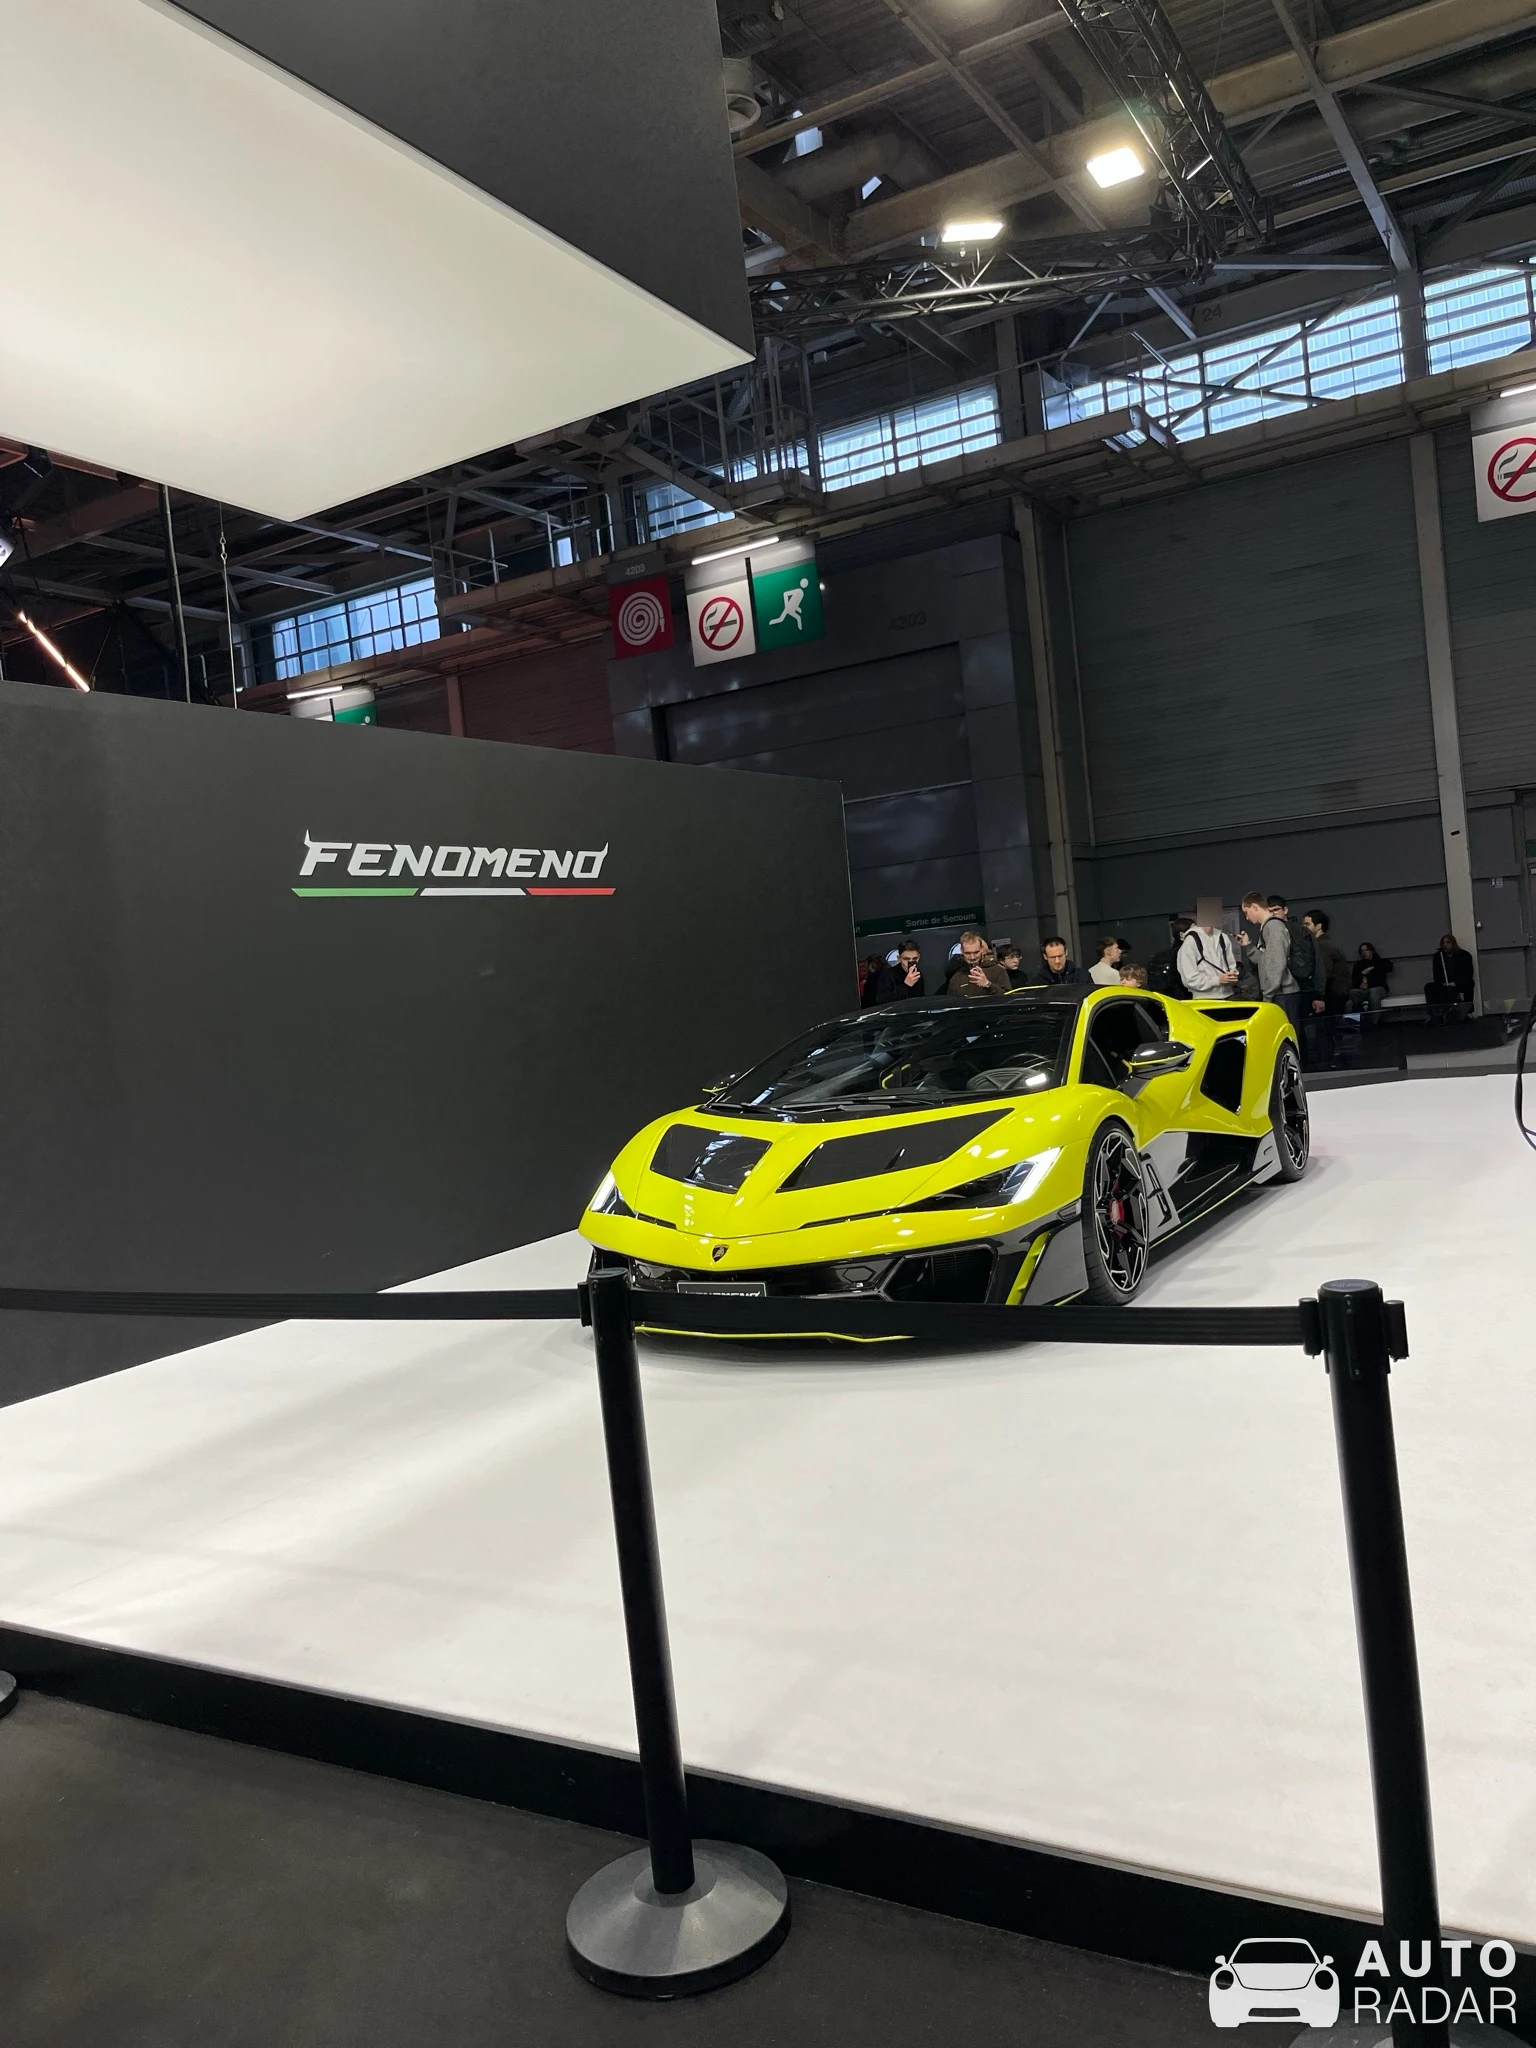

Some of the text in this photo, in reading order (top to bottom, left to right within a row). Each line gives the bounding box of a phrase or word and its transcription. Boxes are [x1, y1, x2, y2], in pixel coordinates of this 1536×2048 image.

[1201, 304, 1222, 322] 24
[625, 563, 646, 575] 4203
[299, 829, 609, 878] FENOMENO
[906, 913, 976, 928] Sortie de Secours
